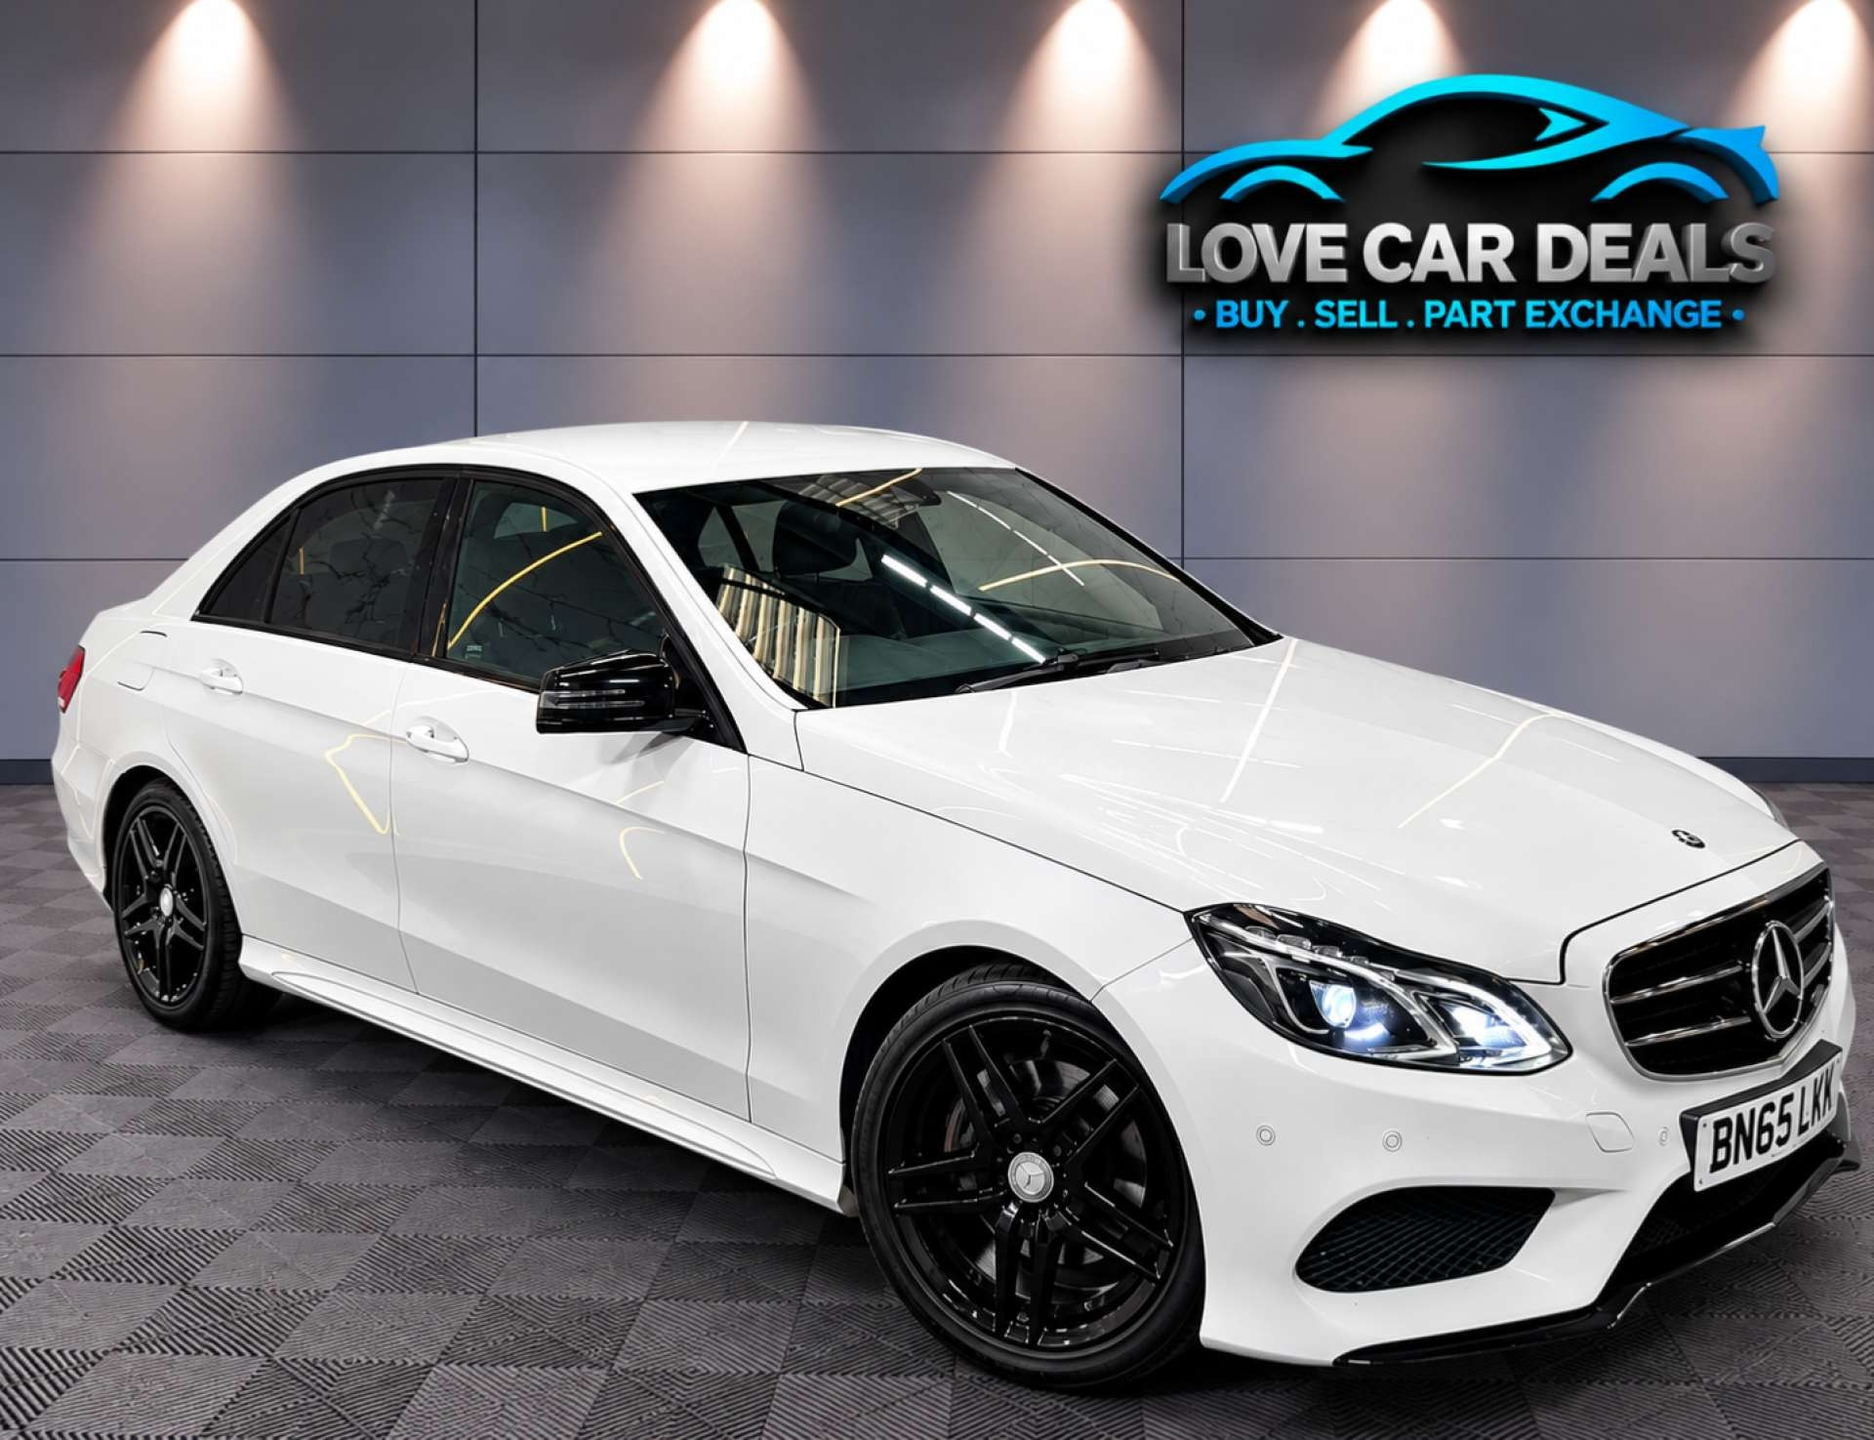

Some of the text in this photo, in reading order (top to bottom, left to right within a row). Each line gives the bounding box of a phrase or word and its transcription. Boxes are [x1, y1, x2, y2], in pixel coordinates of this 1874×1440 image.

[1166, 222, 1776, 283] LOVE CAR DEALS
[1215, 300, 1722, 328] BUY SELL PART EXCHANGE
[1709, 1063, 1835, 1174] BN65 LKK
